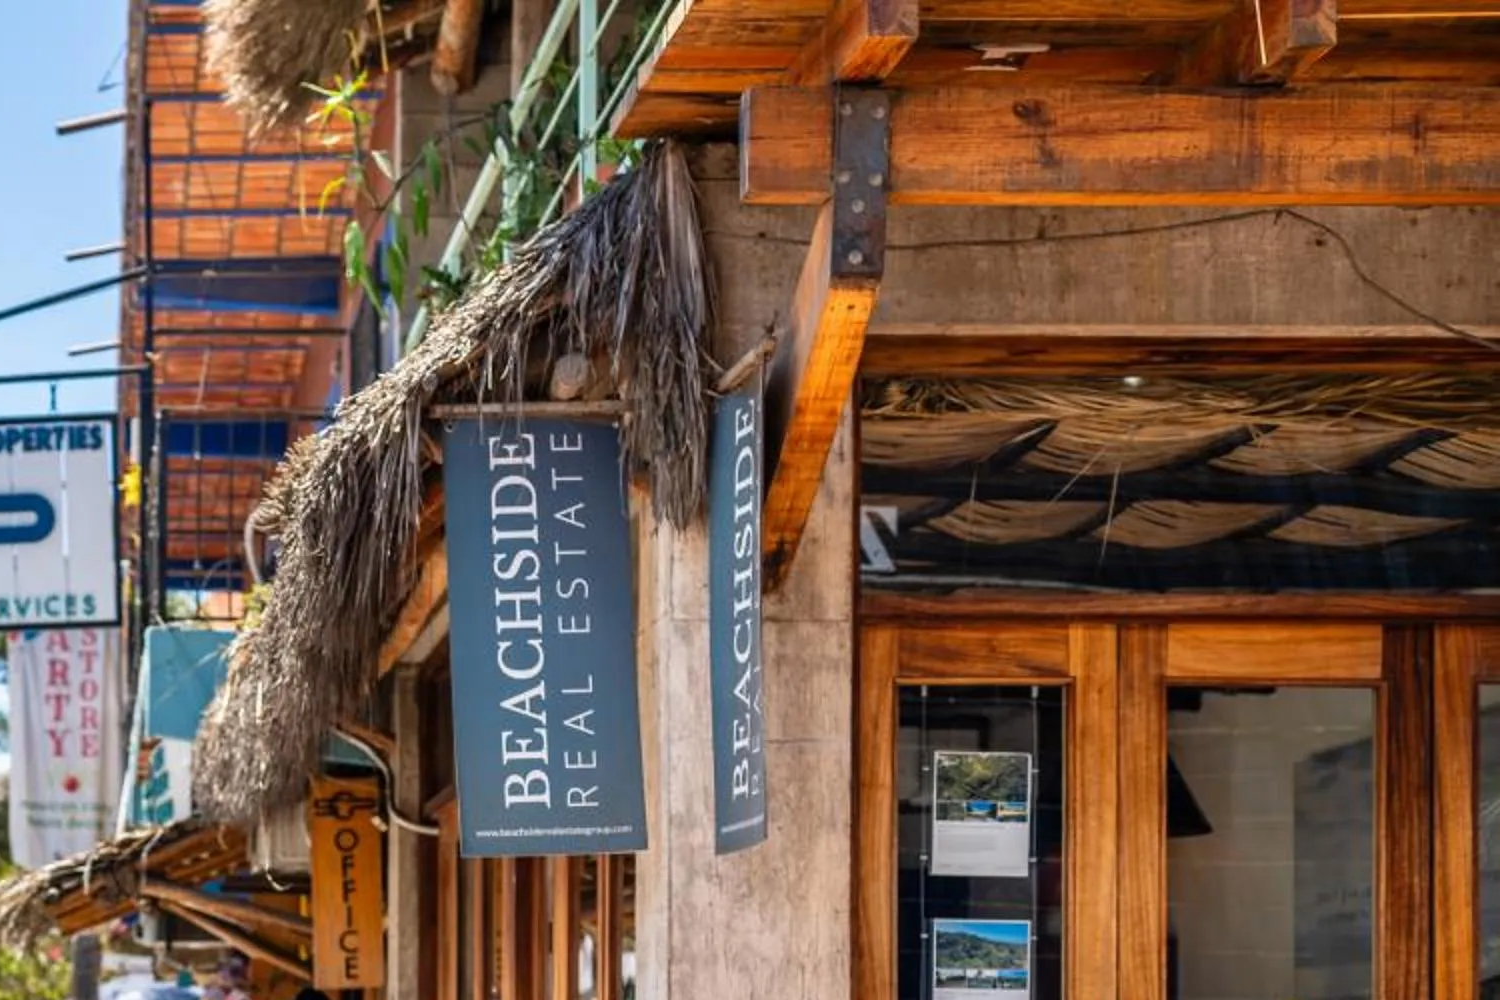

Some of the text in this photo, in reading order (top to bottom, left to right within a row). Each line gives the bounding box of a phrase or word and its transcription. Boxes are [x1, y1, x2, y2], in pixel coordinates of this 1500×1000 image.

[488, 433, 551, 810] BEACHSIDE
[550, 432, 600, 808] REAL ESTATE
[731, 399, 756, 801] BEACHSIDE
[334, 827, 360, 981] OFFICE
